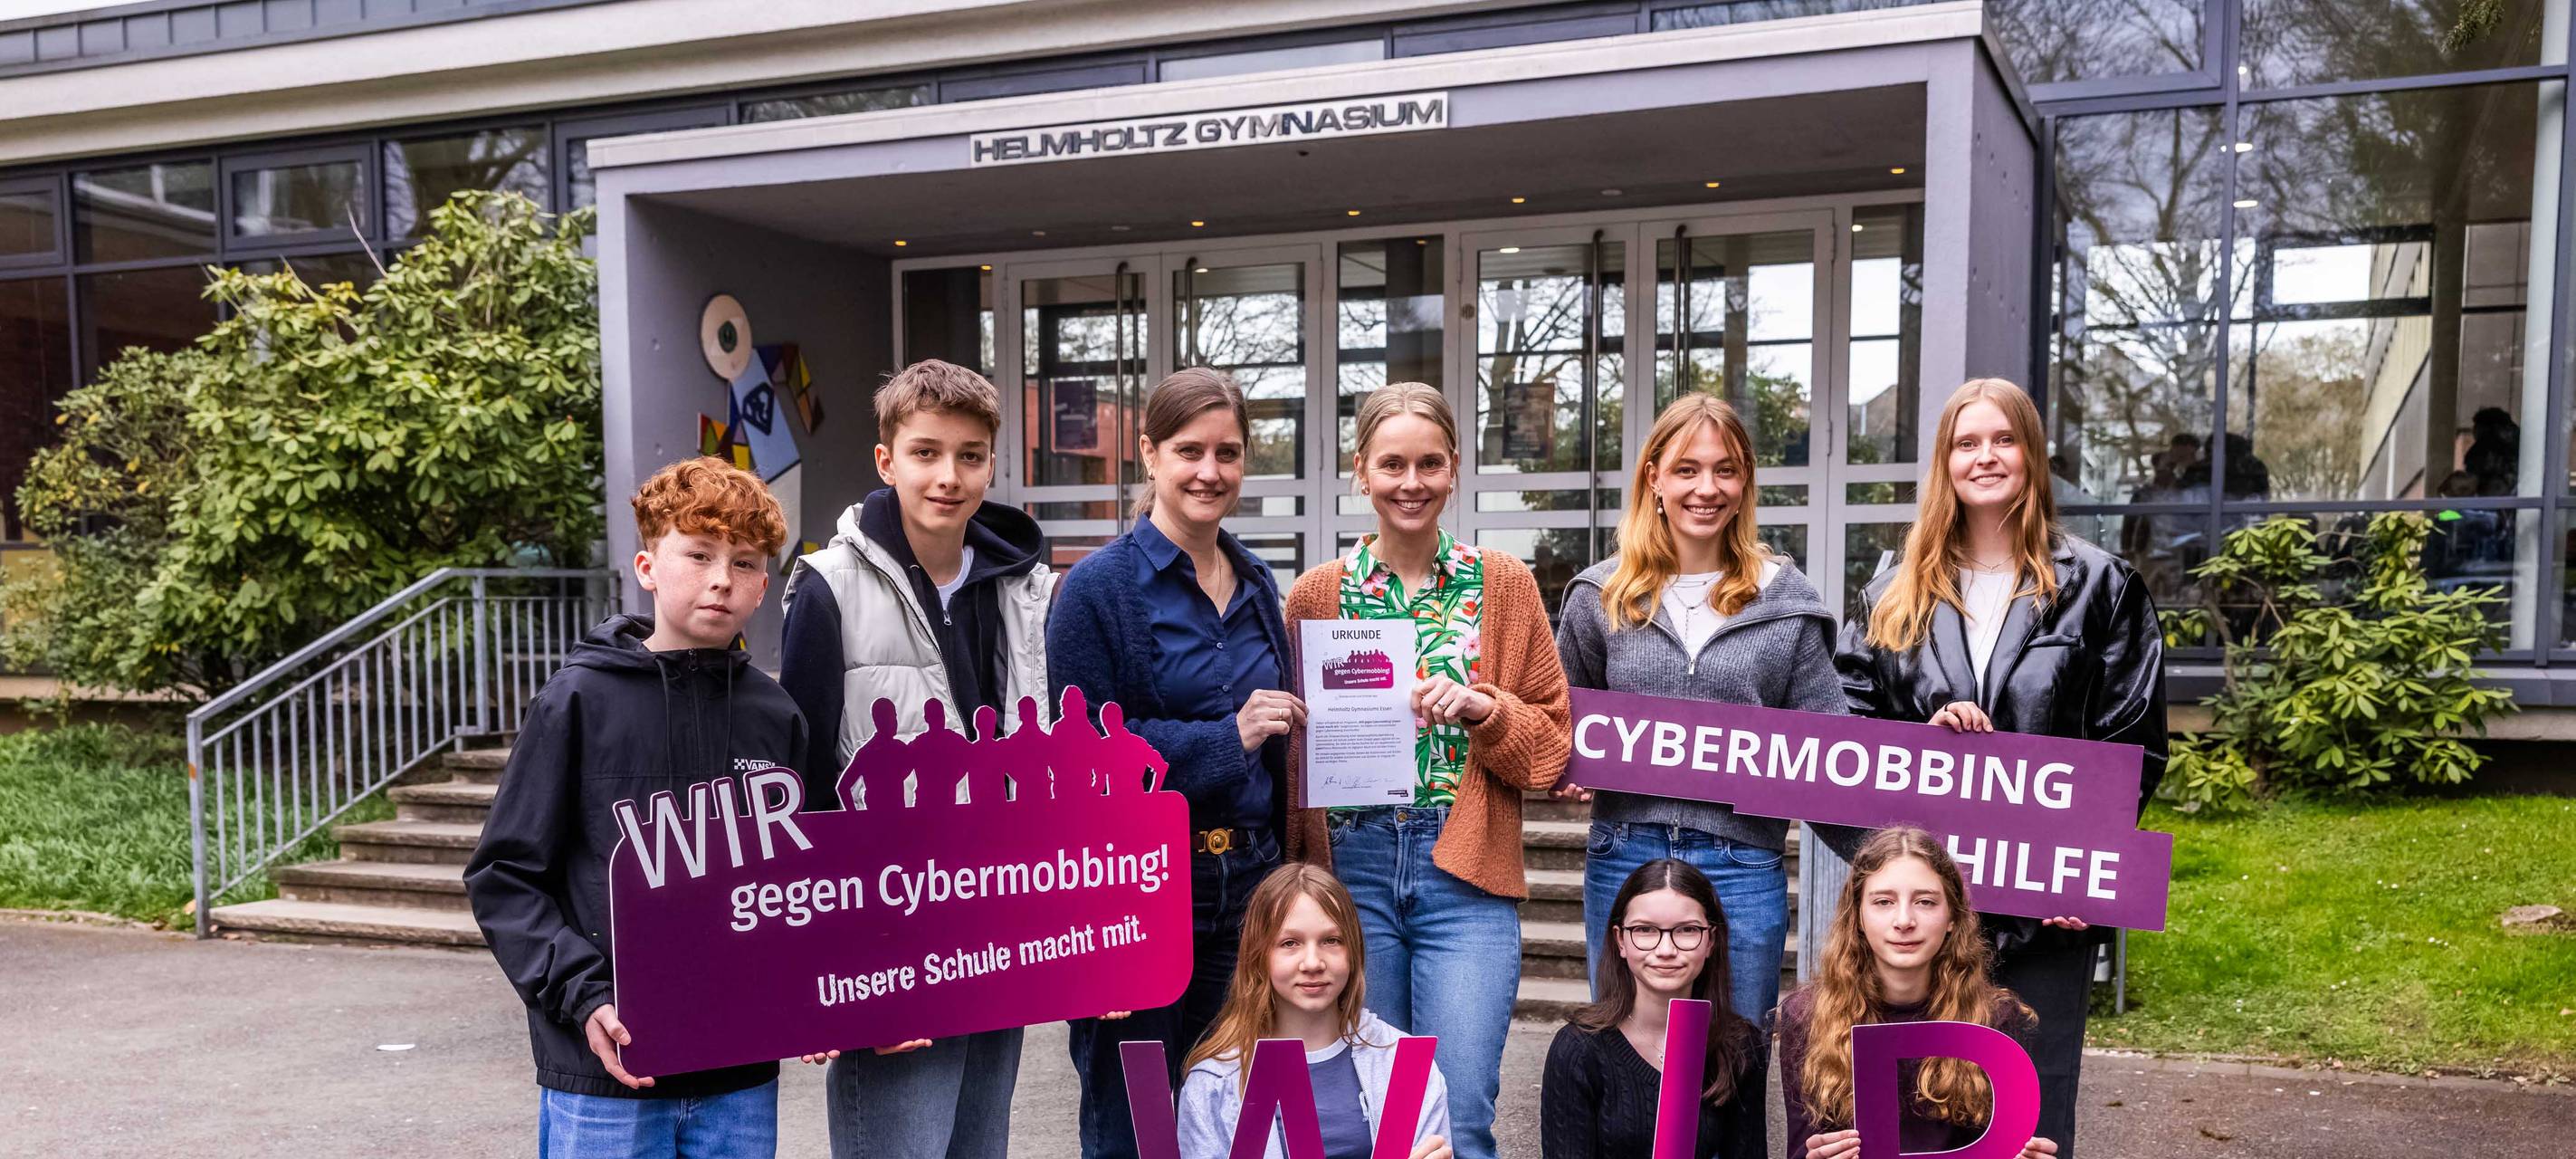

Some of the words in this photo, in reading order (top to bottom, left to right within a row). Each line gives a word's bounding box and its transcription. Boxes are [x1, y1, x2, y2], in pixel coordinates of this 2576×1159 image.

[974, 121, 1188, 163] HELMHOLTZ
[1194, 99, 1444, 143] GYMNASIUM
[1321, 657, 1345, 671] WIR
[1331, 629, 1381, 640] URKUNDE
[1574, 714, 2075, 809] CYBERMOBBING
[619, 771, 814, 889] WIR
[1946, 834, 2121, 900] HILFE
[730, 876, 863, 932] gegen
[879, 843, 1169, 916] Cybermobbing!
[817, 965, 915, 1007] Unsere
[923, 942, 1011, 985] Schule
[1018, 924, 1095, 966] macht
[1102, 915, 1148, 949] mit.
